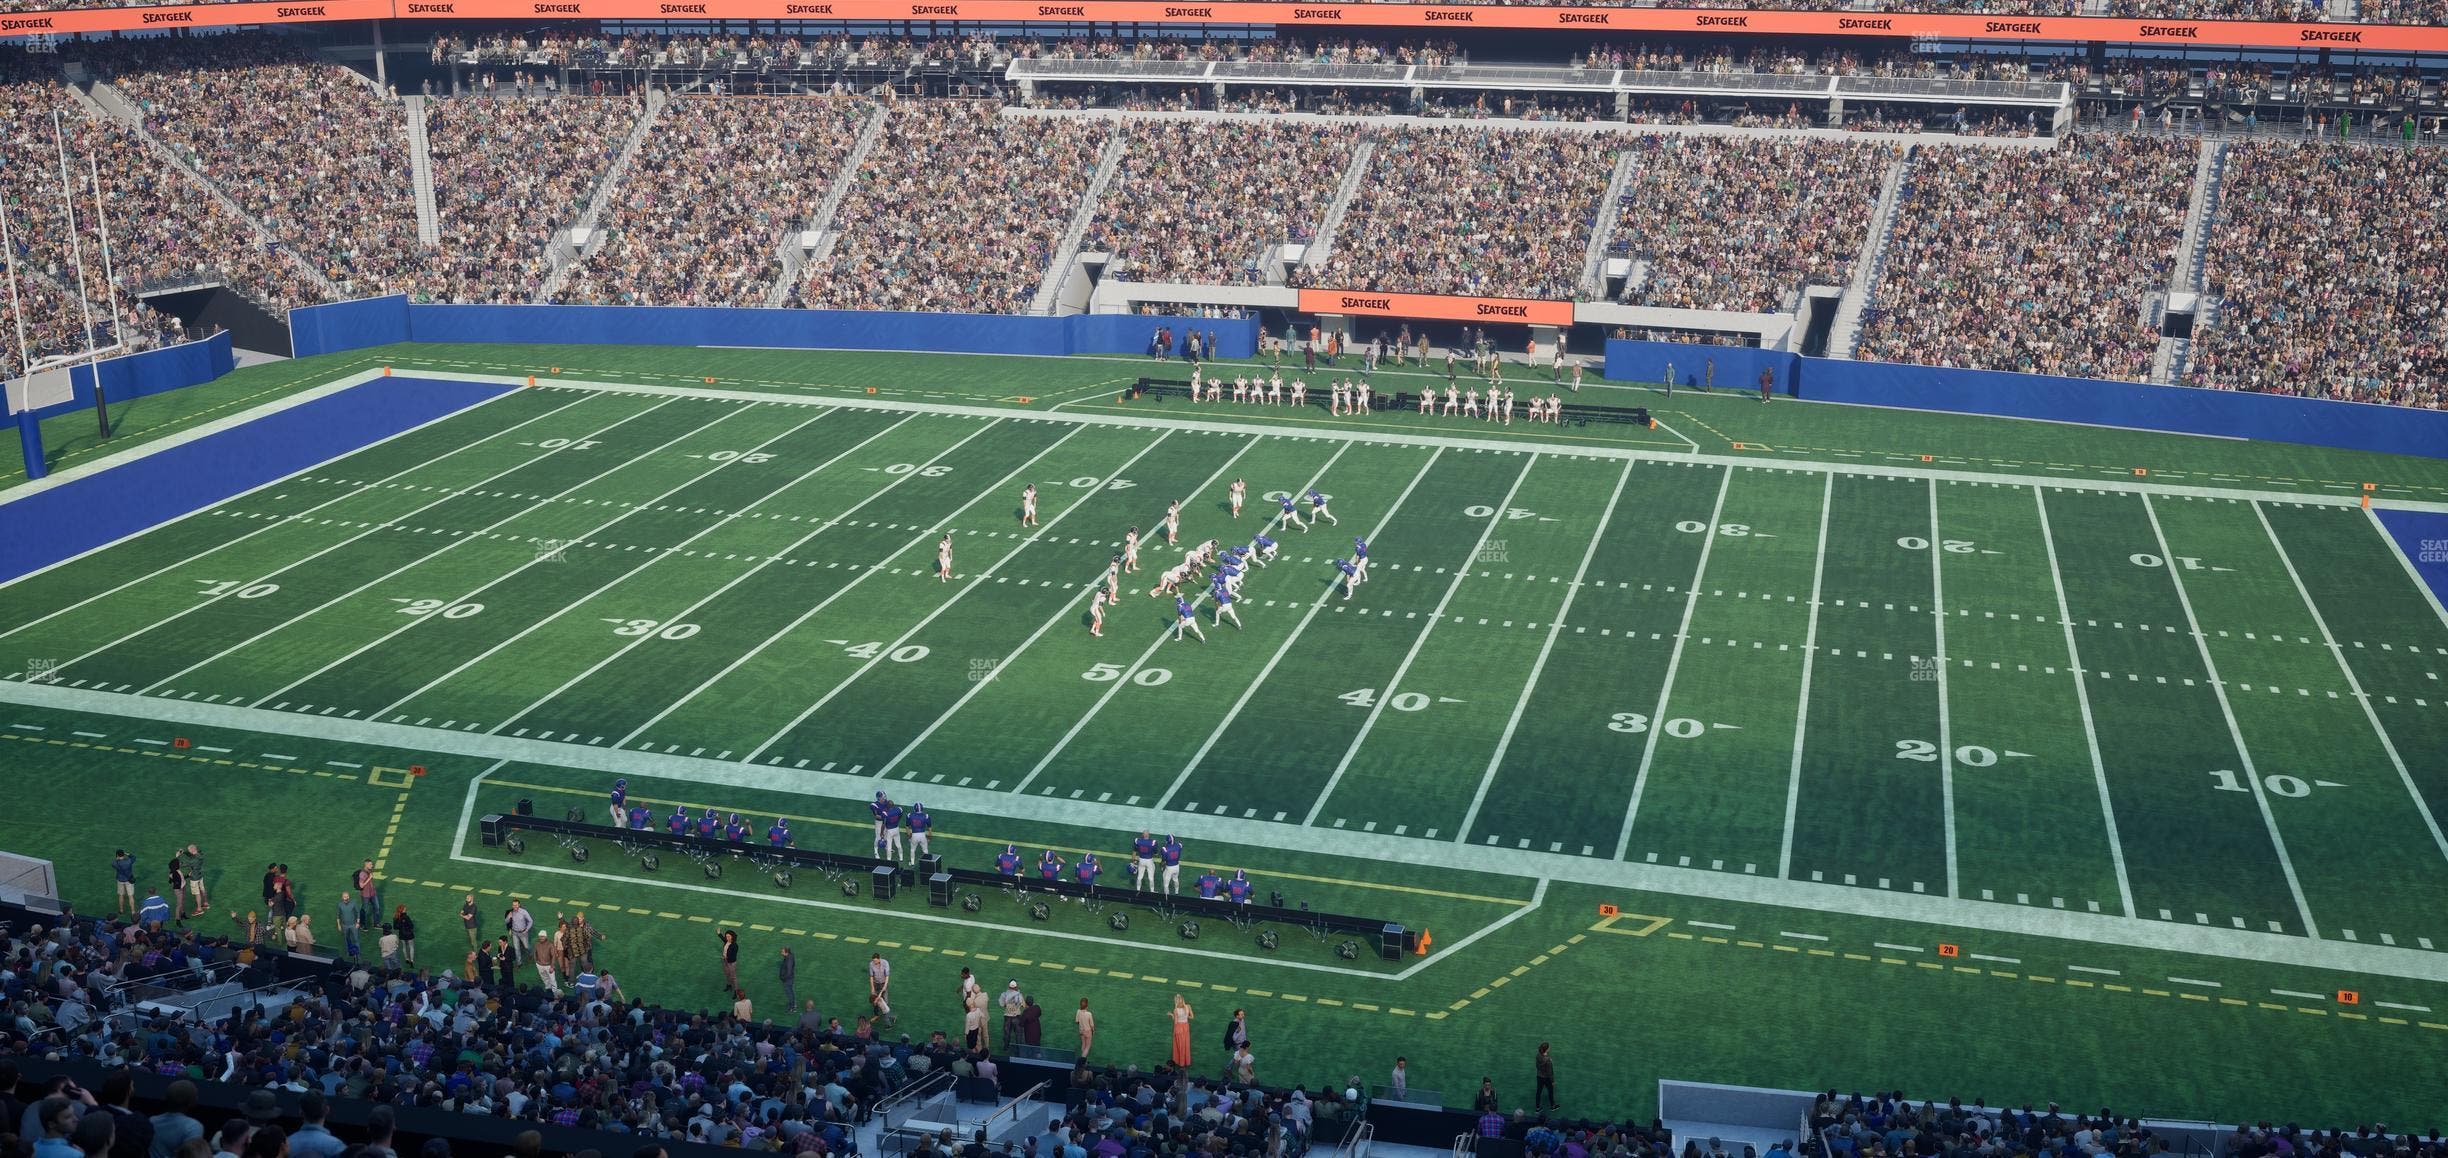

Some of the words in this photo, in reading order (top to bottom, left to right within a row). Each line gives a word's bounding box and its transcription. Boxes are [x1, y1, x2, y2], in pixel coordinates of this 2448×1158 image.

[277, 6, 326, 18] SEATGEEK
[408, 3, 454, 14] SEATGEEK
[534, 3, 581, 14] SEATGEEK
[660, 3, 707, 14] SEATGEEK
[786, 4, 833, 14] SEATGEEK
[911, 5, 958, 15] SEATGEEK
[1038, 5, 1085, 17] SEATGEEK
[1165, 7, 1212, 18] SEATGEEK
[1294, 8, 1342, 20] SEATGEEK
[142, 11, 193, 24] SEATGEEK
[1425, 10, 1473, 22] SEATGEEK
[1559, 12, 1609, 24] SEATGEEK
[1696, 15, 1748, 27] SEATGEEK
[0, 17, 54, 31] SEATGEEK
[1838, 18, 1892, 31] SEATGEEK
[1985, 21, 2041, 34] SEATGEEK
[2139, 25, 2198, 39] SEATGEEK
[2300, 29, 2362, 43] SEATGEEK
[1341, 296, 1391, 311] SEATGEEK
[1476, 303, 1528, 318] SEATGEEK
[539, 438, 602, 450] 10
[708, 450, 778, 463] 20
[884, 463, 953, 477] 30
[1069, 476, 1138, 490] 40
[1464, 505, 1536, 519] 40
[1675, 520, 1750, 537] 30
[1897, 536, 1975, 553] 20
[2129, 553, 2205, 570] 10
[197, 580, 280, 598] 10
[395, 599, 485, 619] 20
[613, 619, 701, 640] 30
[844, 641, 930, 662] 40
[1081, 662, 1173, 686] 50
[1338, 687, 1430, 712] 40
[1607, 712, 1706, 738] 30
[1895, 739, 1998, 767] 20
[2208, 769, 2312, 798] 10
[1604, 906, 1614, 914] 30
[1943, 946, 1954, 955] 20
[2344, 993, 2352, 1001] 10
